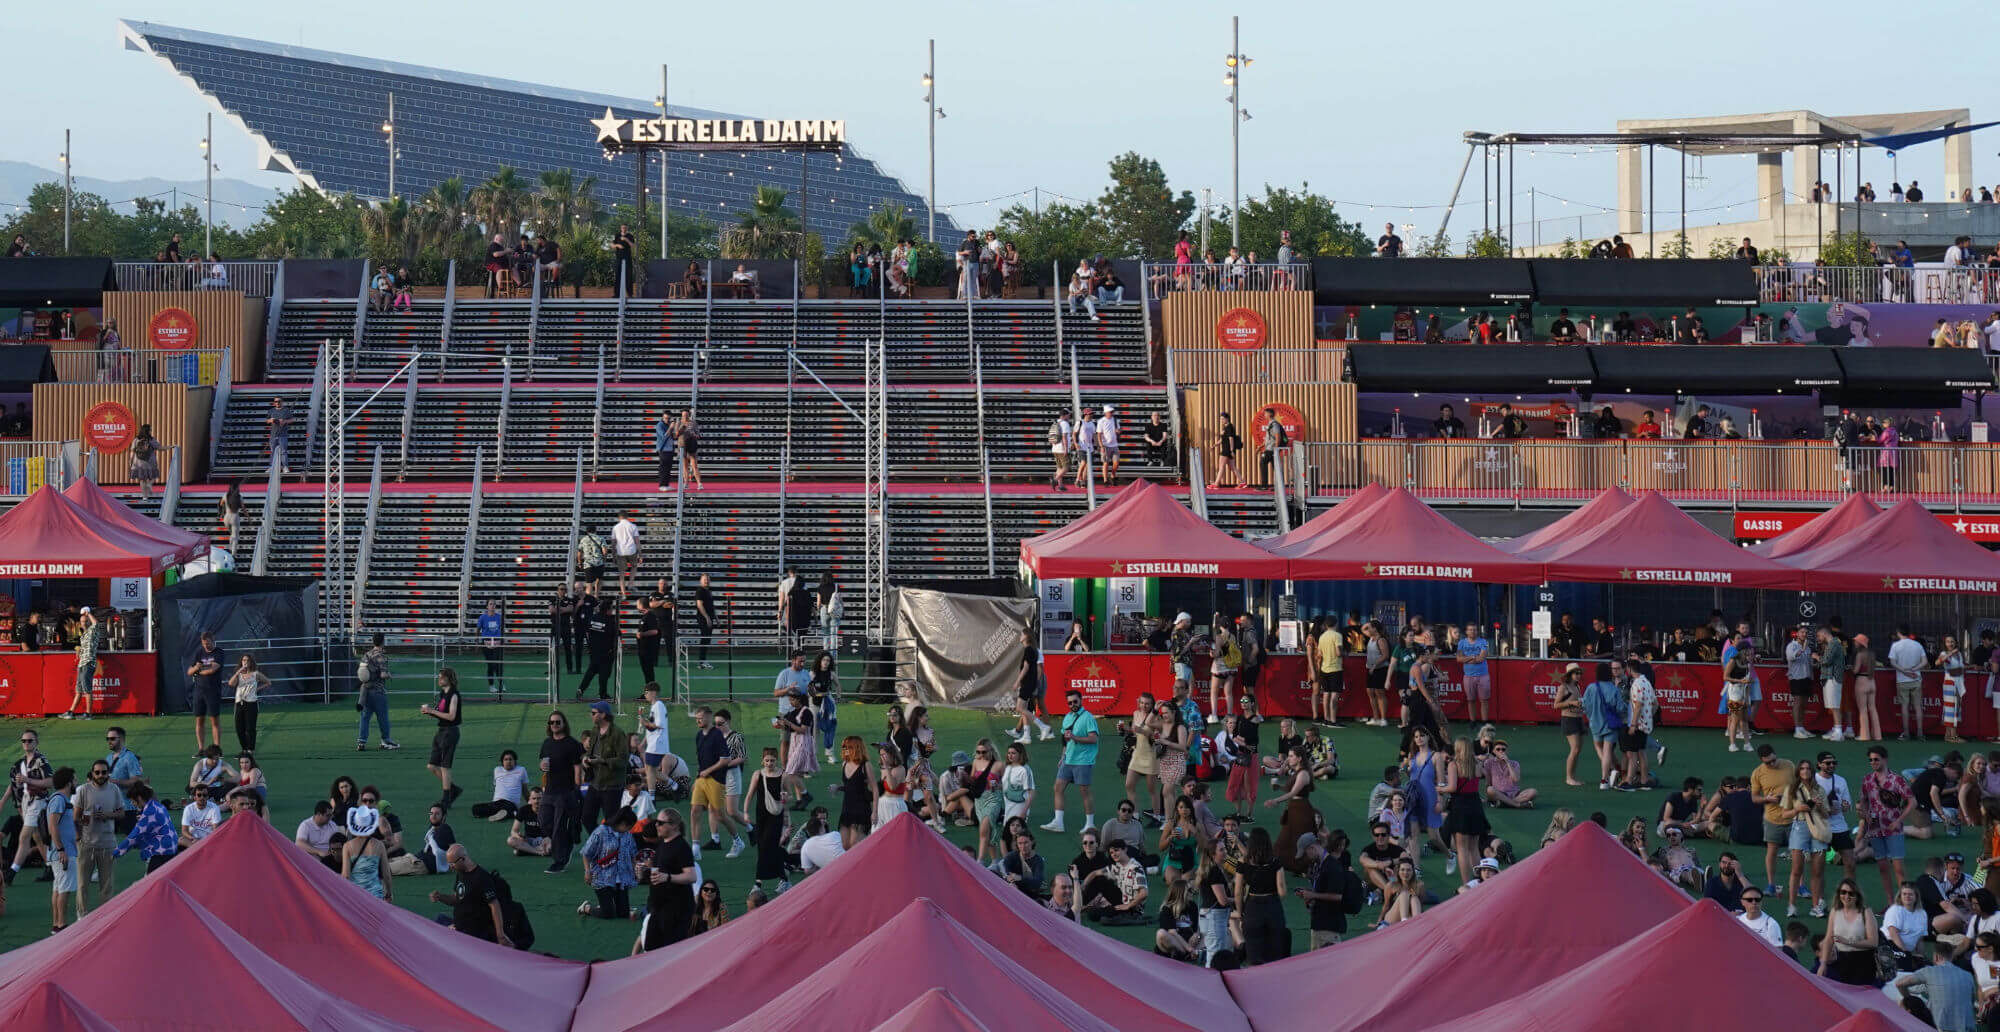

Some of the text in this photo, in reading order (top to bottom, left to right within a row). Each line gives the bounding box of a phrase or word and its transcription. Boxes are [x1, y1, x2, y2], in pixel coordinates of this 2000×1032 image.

[632, 119, 845, 142] ESTRELLA DAMM
[93, 423, 126, 431] ESTRELLA
[1743, 519, 1783, 530] OASSIS
[1971, 523, 2000, 534] ESTR
[0, 564, 84, 575] STRELLA DAMM
[1126, 562, 1219, 575] ESTRELLA DAMM
[1379, 565, 1473, 578] ESTRELLA DAMM
[1636, 570, 1732, 583] ESTRELLA DAMM
[1898, 578, 1997, 592] ESTRELLA DAMM
[1540, 592, 1554, 601] B2
[92, 678, 121, 687] RELLA
[1071, 679, 1116, 688] ESTRELLA
[1533, 685, 1559, 695] ESTR
